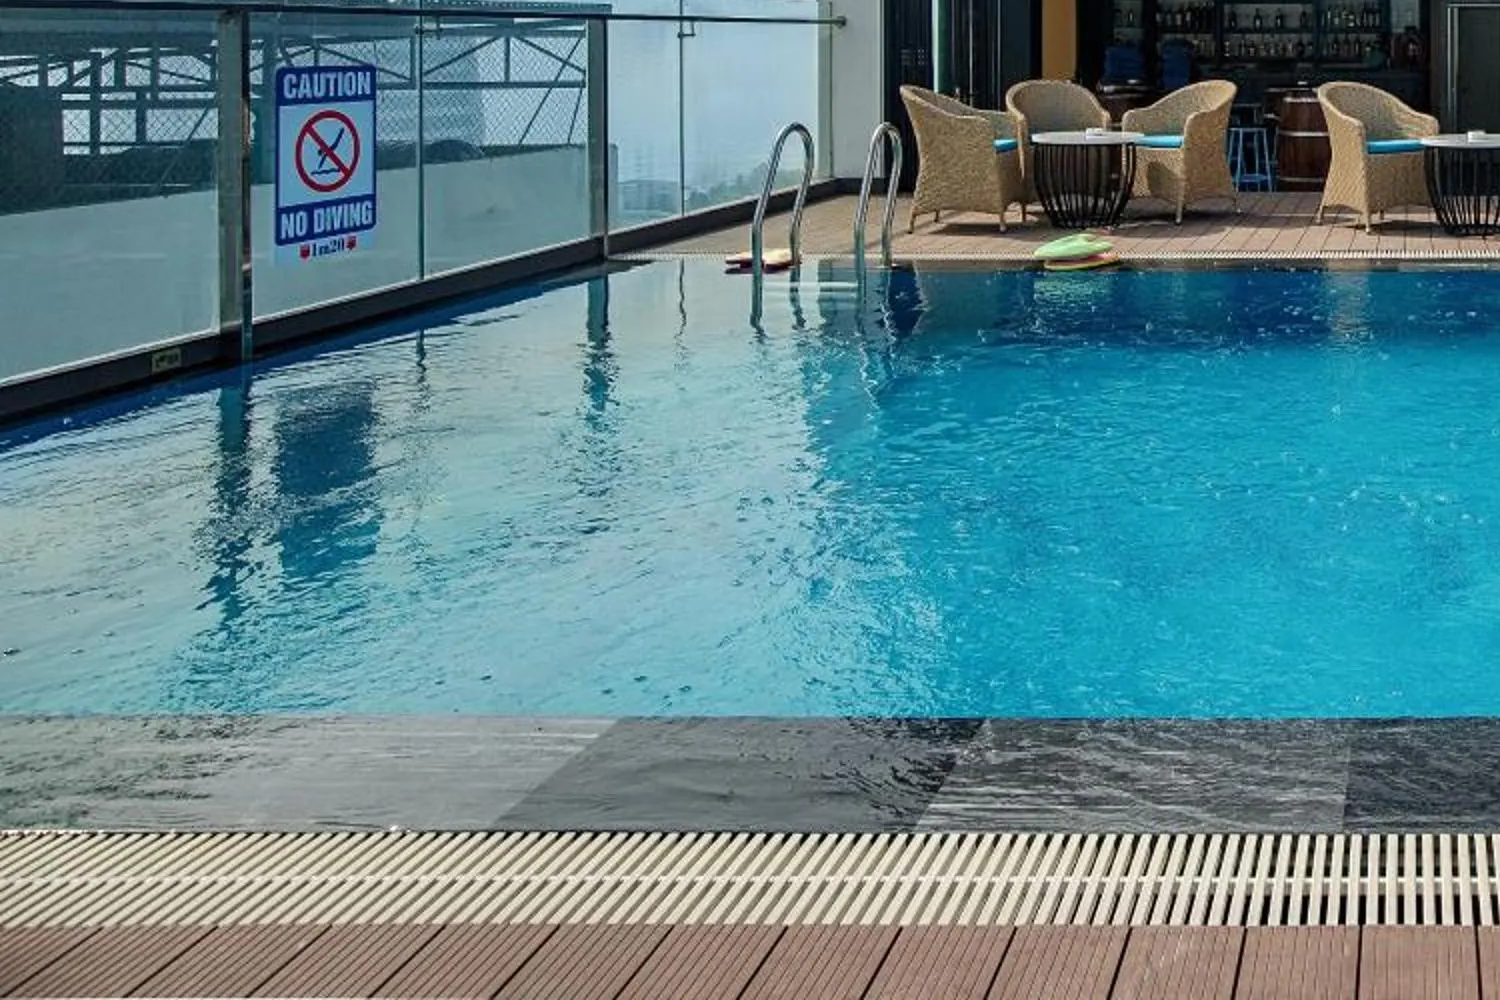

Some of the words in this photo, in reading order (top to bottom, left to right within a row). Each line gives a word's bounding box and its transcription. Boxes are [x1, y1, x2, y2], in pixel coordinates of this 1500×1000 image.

[283, 71, 371, 99] CAUTION
[280, 210, 307, 239] NO
[313, 201, 373, 235] DIVING
